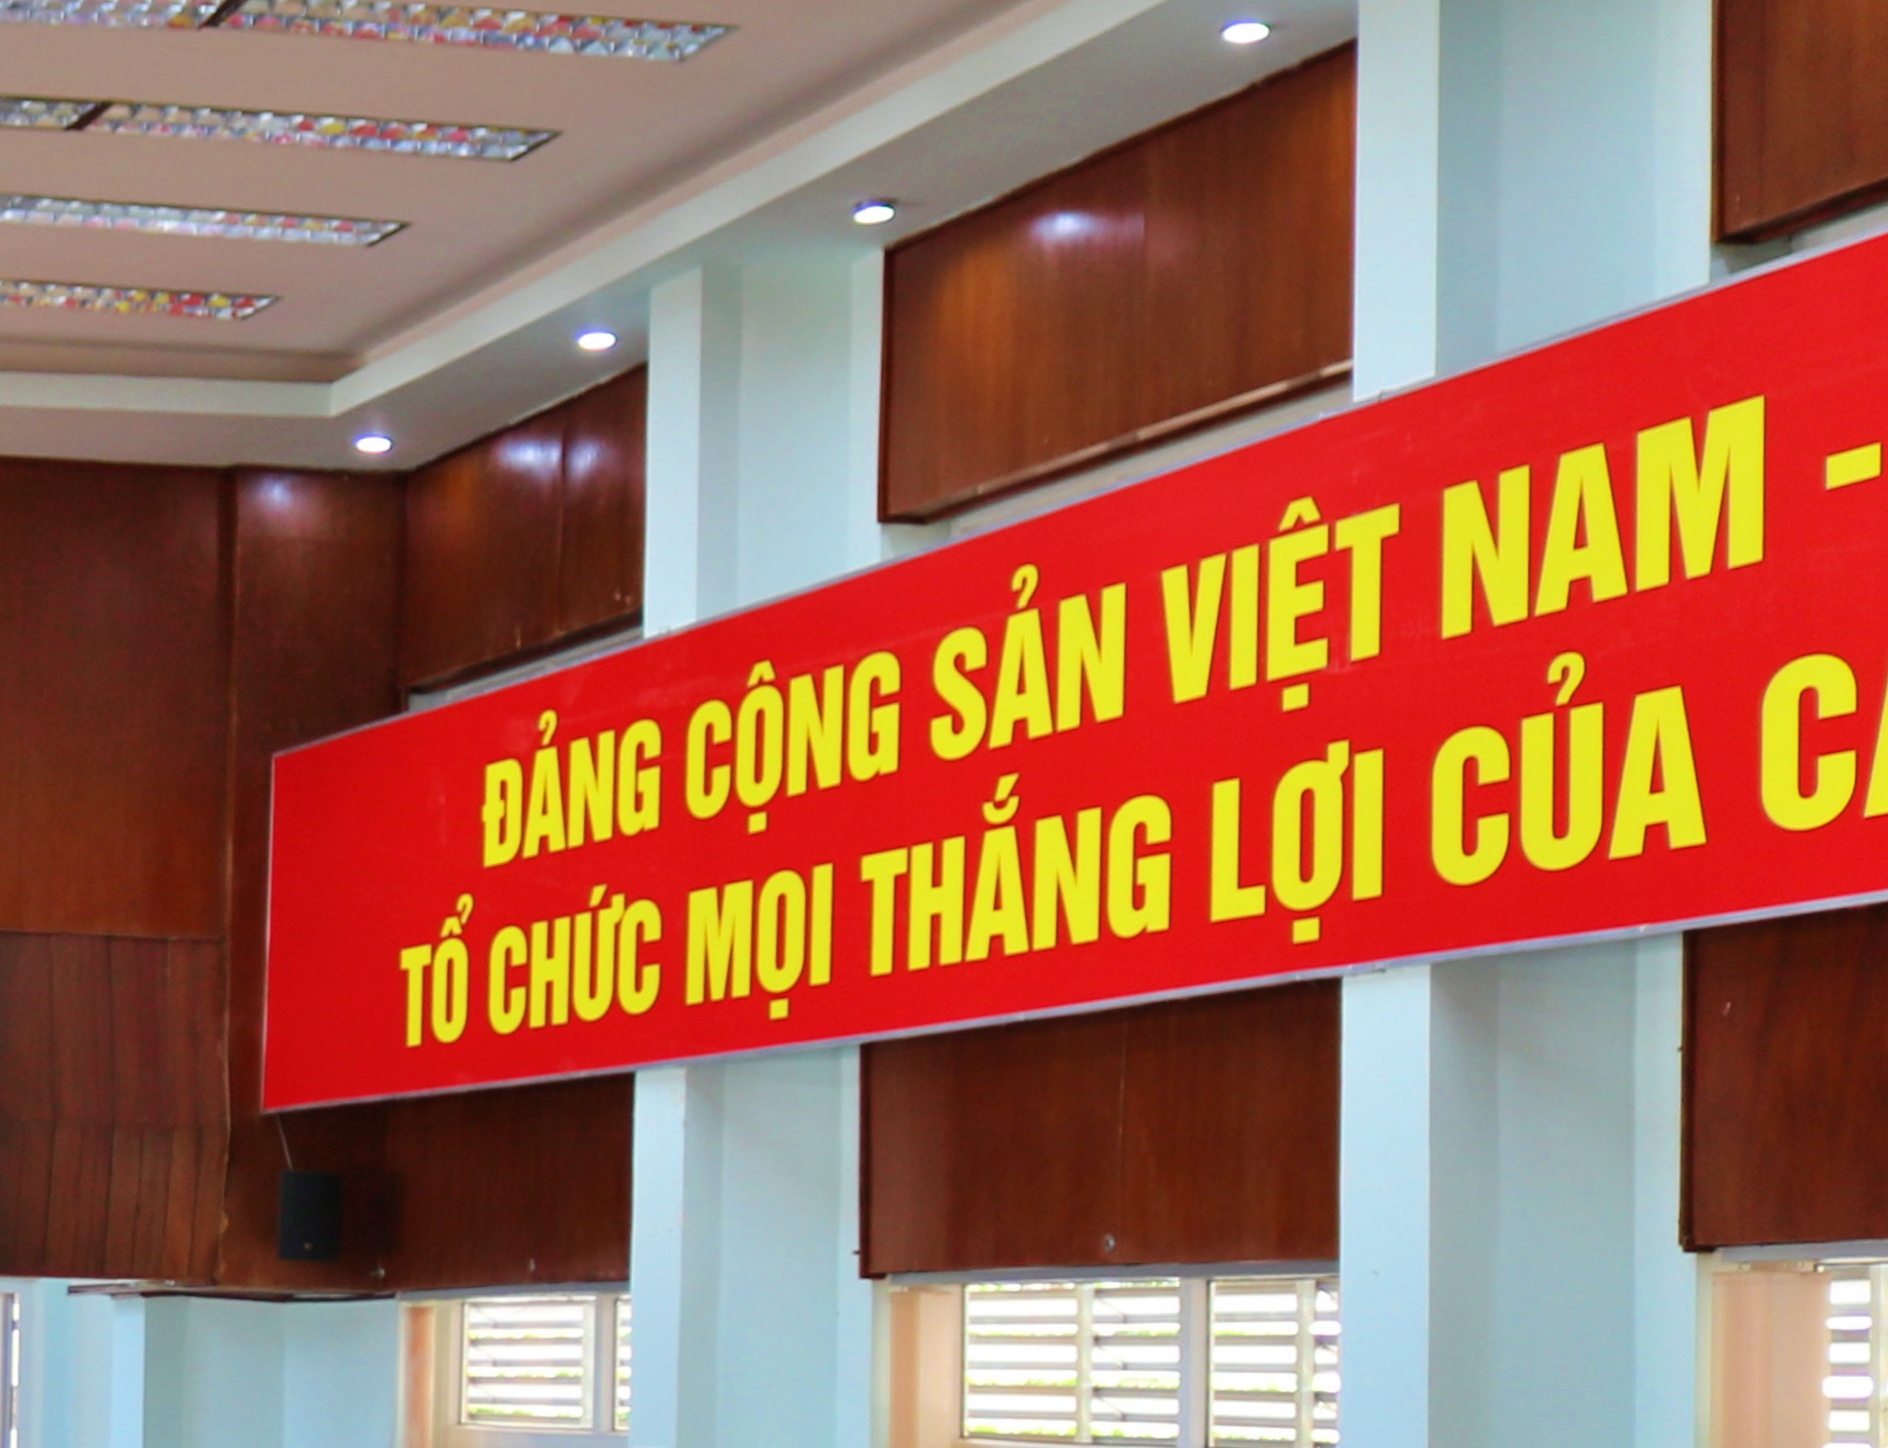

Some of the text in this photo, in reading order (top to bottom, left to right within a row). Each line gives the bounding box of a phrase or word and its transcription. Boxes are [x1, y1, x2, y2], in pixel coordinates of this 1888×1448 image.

[481, 709, 662, 868] ĐẢNG
[685, 652, 901, 834] CỘNG
[929, 564, 1127, 761] SẢN
[1160, 496, 1401, 712] VIỆT
[1441, 395, 1765, 640] NAM
[399, 651, 1888, 1048] TỔ CHỨC MỌI THẮNG LỢI CỦA C
